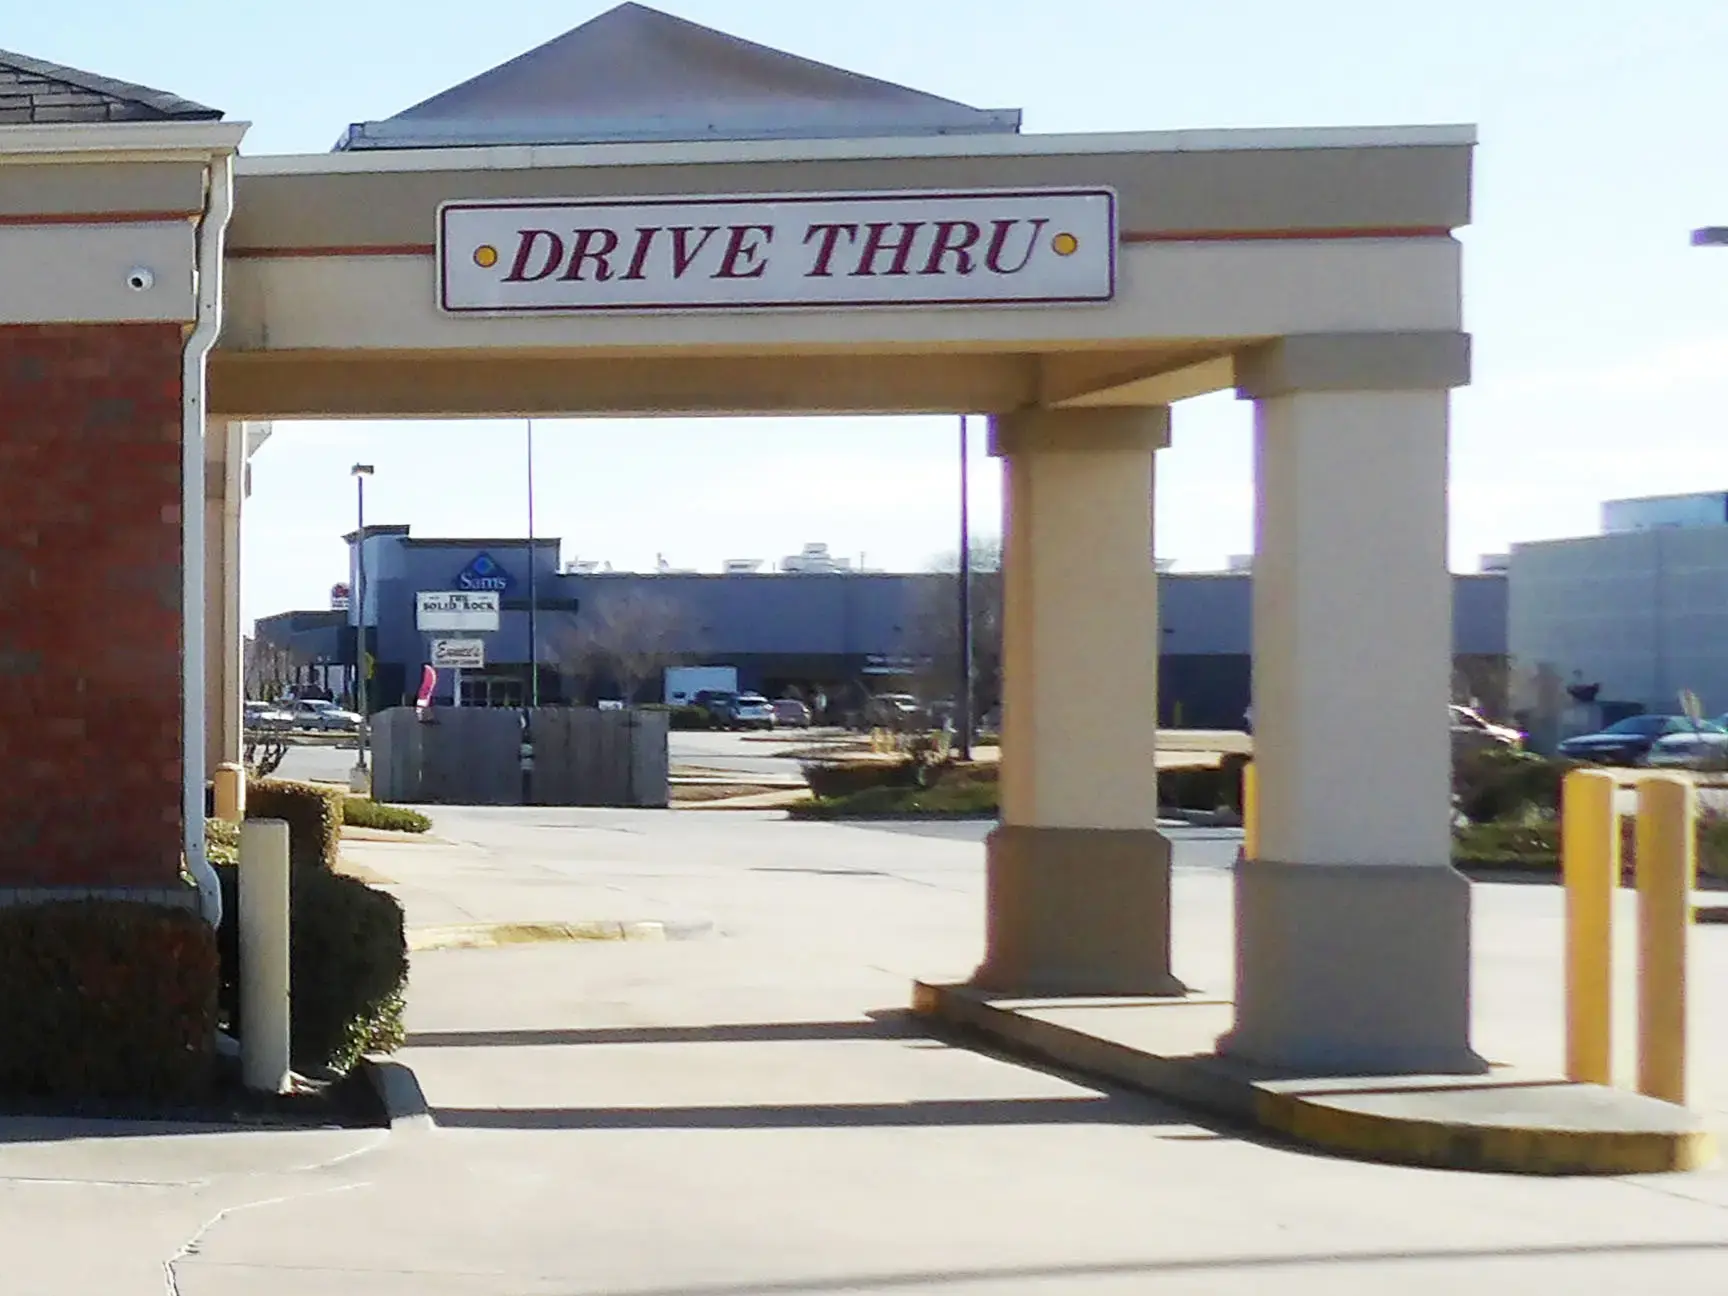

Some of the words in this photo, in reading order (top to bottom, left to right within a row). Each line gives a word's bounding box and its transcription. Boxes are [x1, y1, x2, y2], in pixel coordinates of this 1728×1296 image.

[501, 225, 774, 282] DRIVE
[802, 218, 1049, 276] THRU
[423, 602, 456, 611] SOLID
